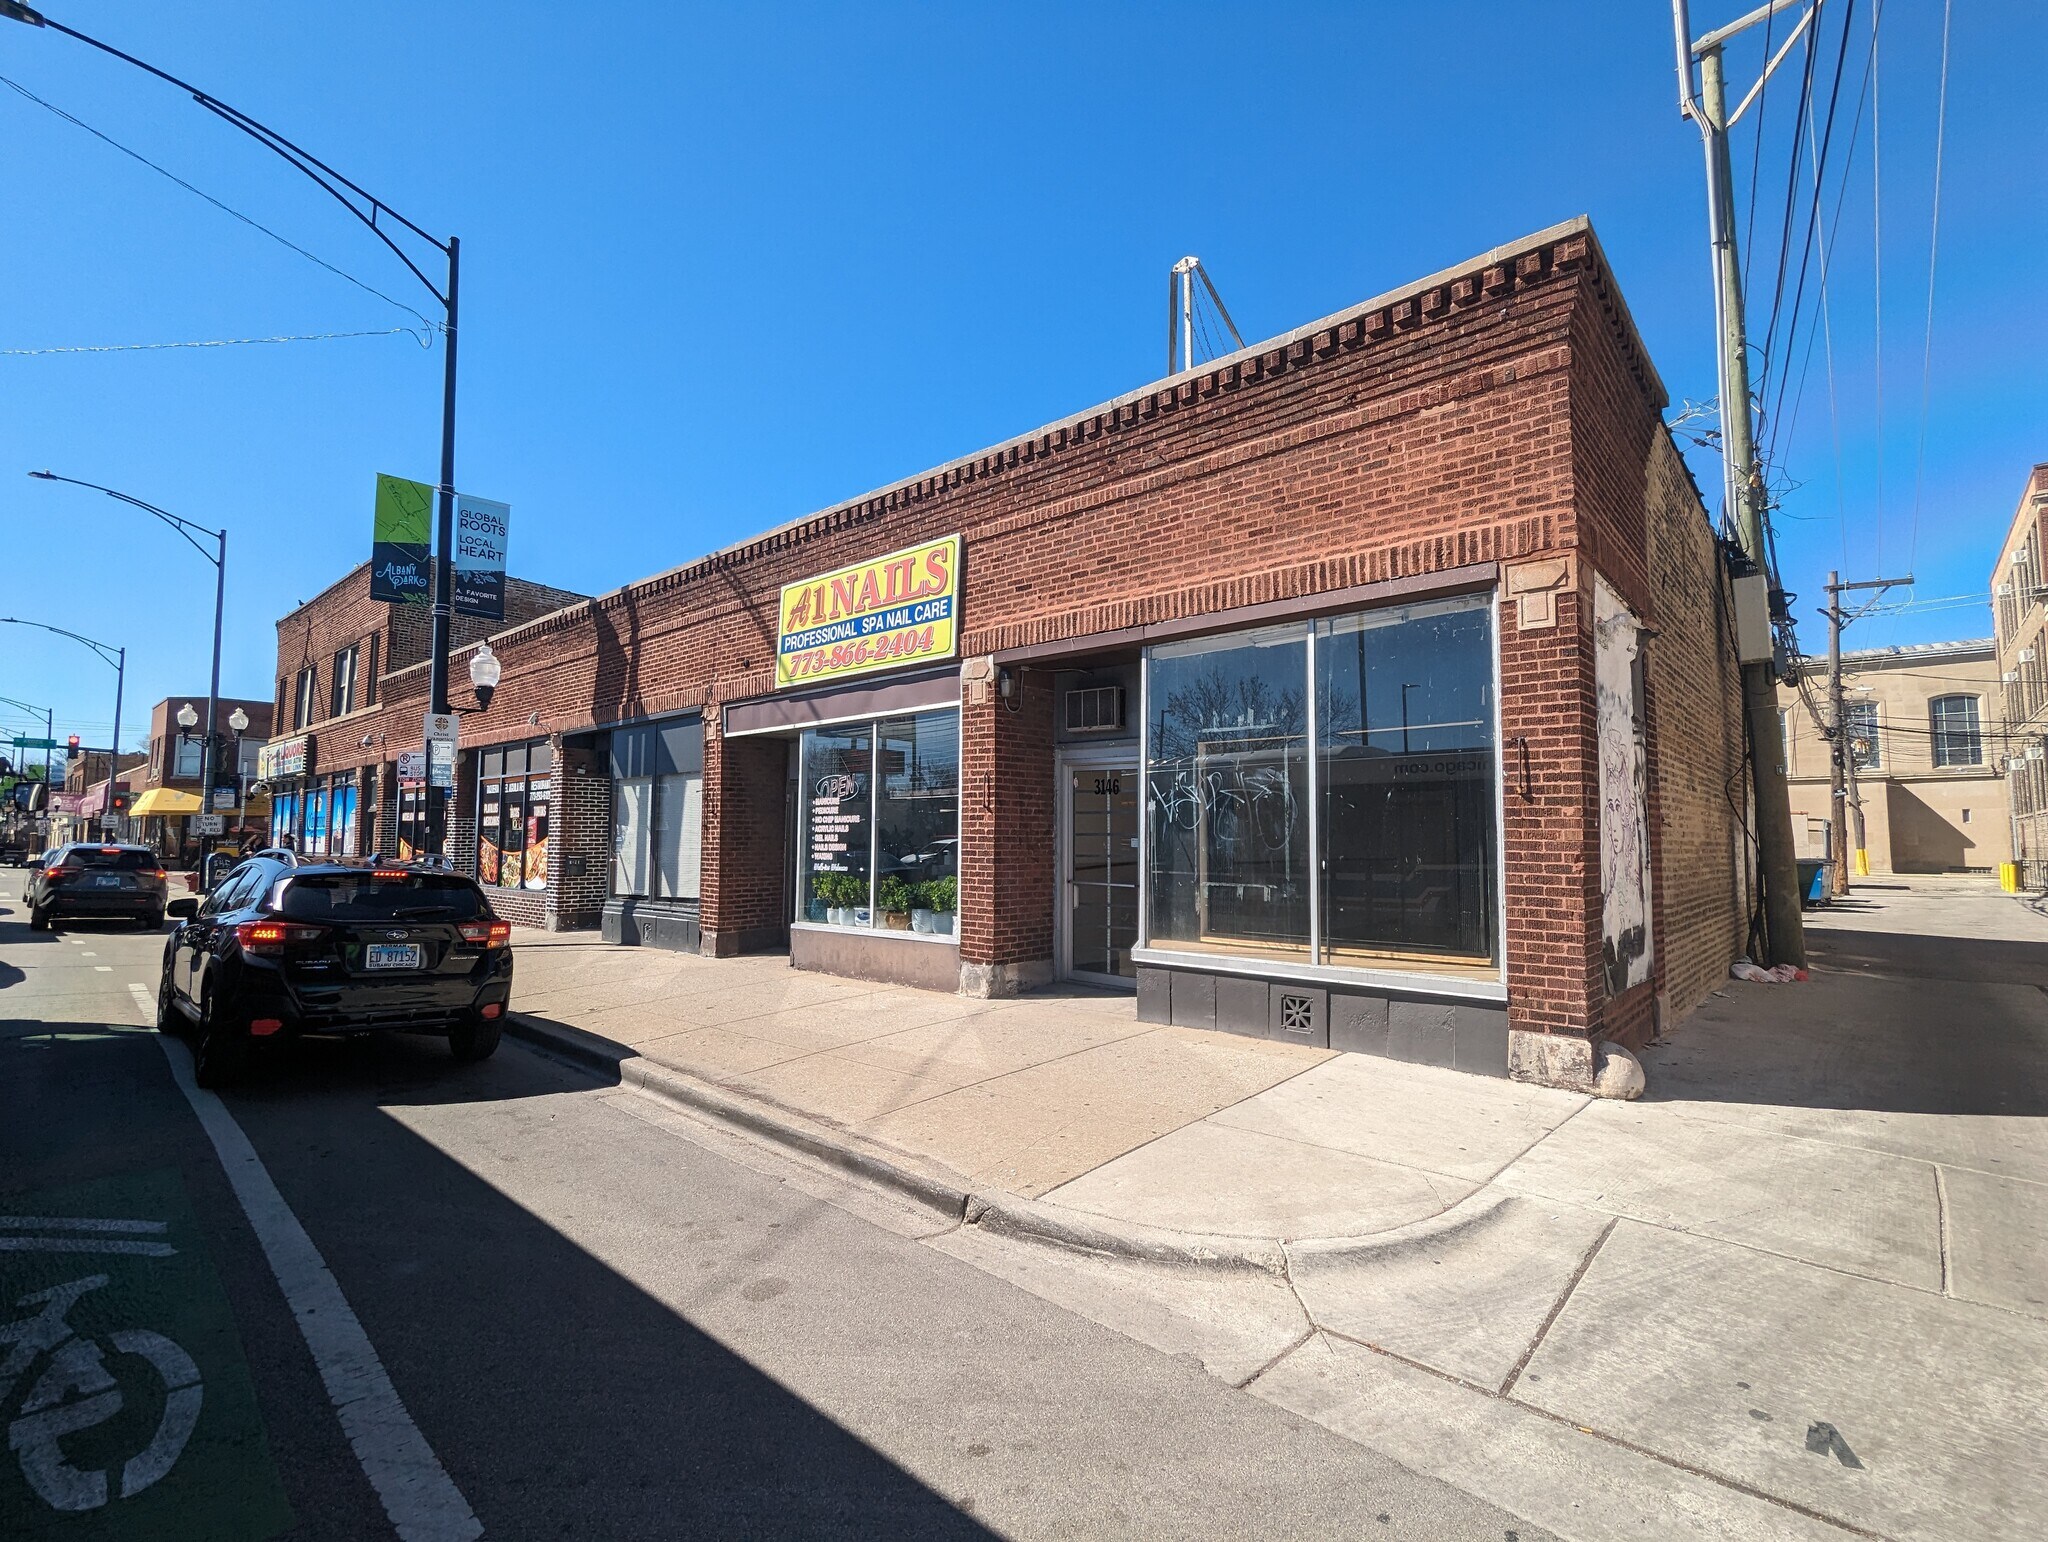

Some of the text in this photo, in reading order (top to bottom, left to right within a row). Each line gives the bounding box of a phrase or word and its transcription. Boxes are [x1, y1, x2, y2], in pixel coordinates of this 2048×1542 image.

[460, 509, 504, 526] GLOBAL
[460, 519, 506, 537] ROOTS
[459, 534, 496, 550] LOCAL
[459, 545, 504, 562] HEART
[376, 562, 417, 579] ALBANY
[392, 575, 427, 590] PARK
[829, 547, 948, 620] NAILS
[455, 595, 479, 605] DESIGN
[466, 589, 498, 601] FAVORITE
[784, 598, 949, 652] PROFESSIONAL SPA NAIL CARE
[789, 625, 935, 677] 773-866-2404
[821, 773, 856, 798] OPEN
[1094, 778, 1120, 795] 3146
[815, 797, 840, 805] MANICURE
[815, 806, 839, 814] PEDICURE
[814, 815, 860, 823] NO CHIP MANICURE
[814, 825, 850, 833] ACRYLIC NAILS
[814, 834, 839, 842] GEL NAILS
[814, 843, 847, 851] NAILS DESIGN
[387, 950, 417, 963] 87152
